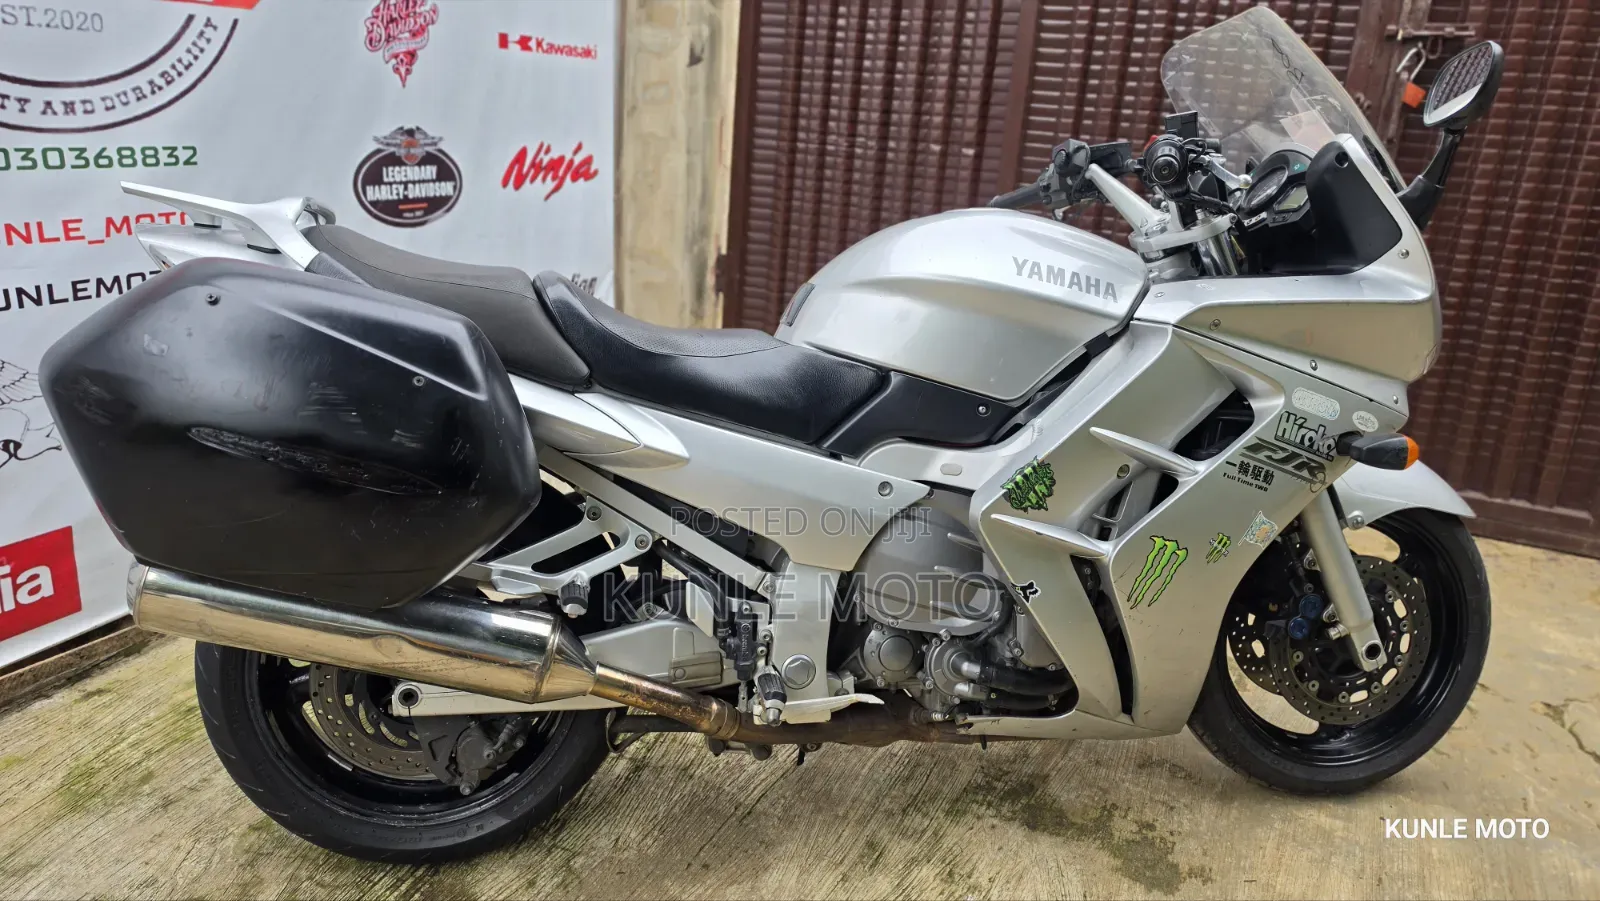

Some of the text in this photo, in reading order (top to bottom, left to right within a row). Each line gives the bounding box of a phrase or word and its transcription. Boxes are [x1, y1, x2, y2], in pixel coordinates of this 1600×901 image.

[535, 37, 598, 61] Kawasaki
[40, 99, 96, 116] AND
[382, 165, 438, 183] LEGENDARY
[501, 141, 599, 201] Ninja
[366, 181, 455, 202] HARLEY-DAVIDSON
[1012, 255, 1119, 303] YAMAHA
[1226, 459, 1275, 486] 一輪駆動
